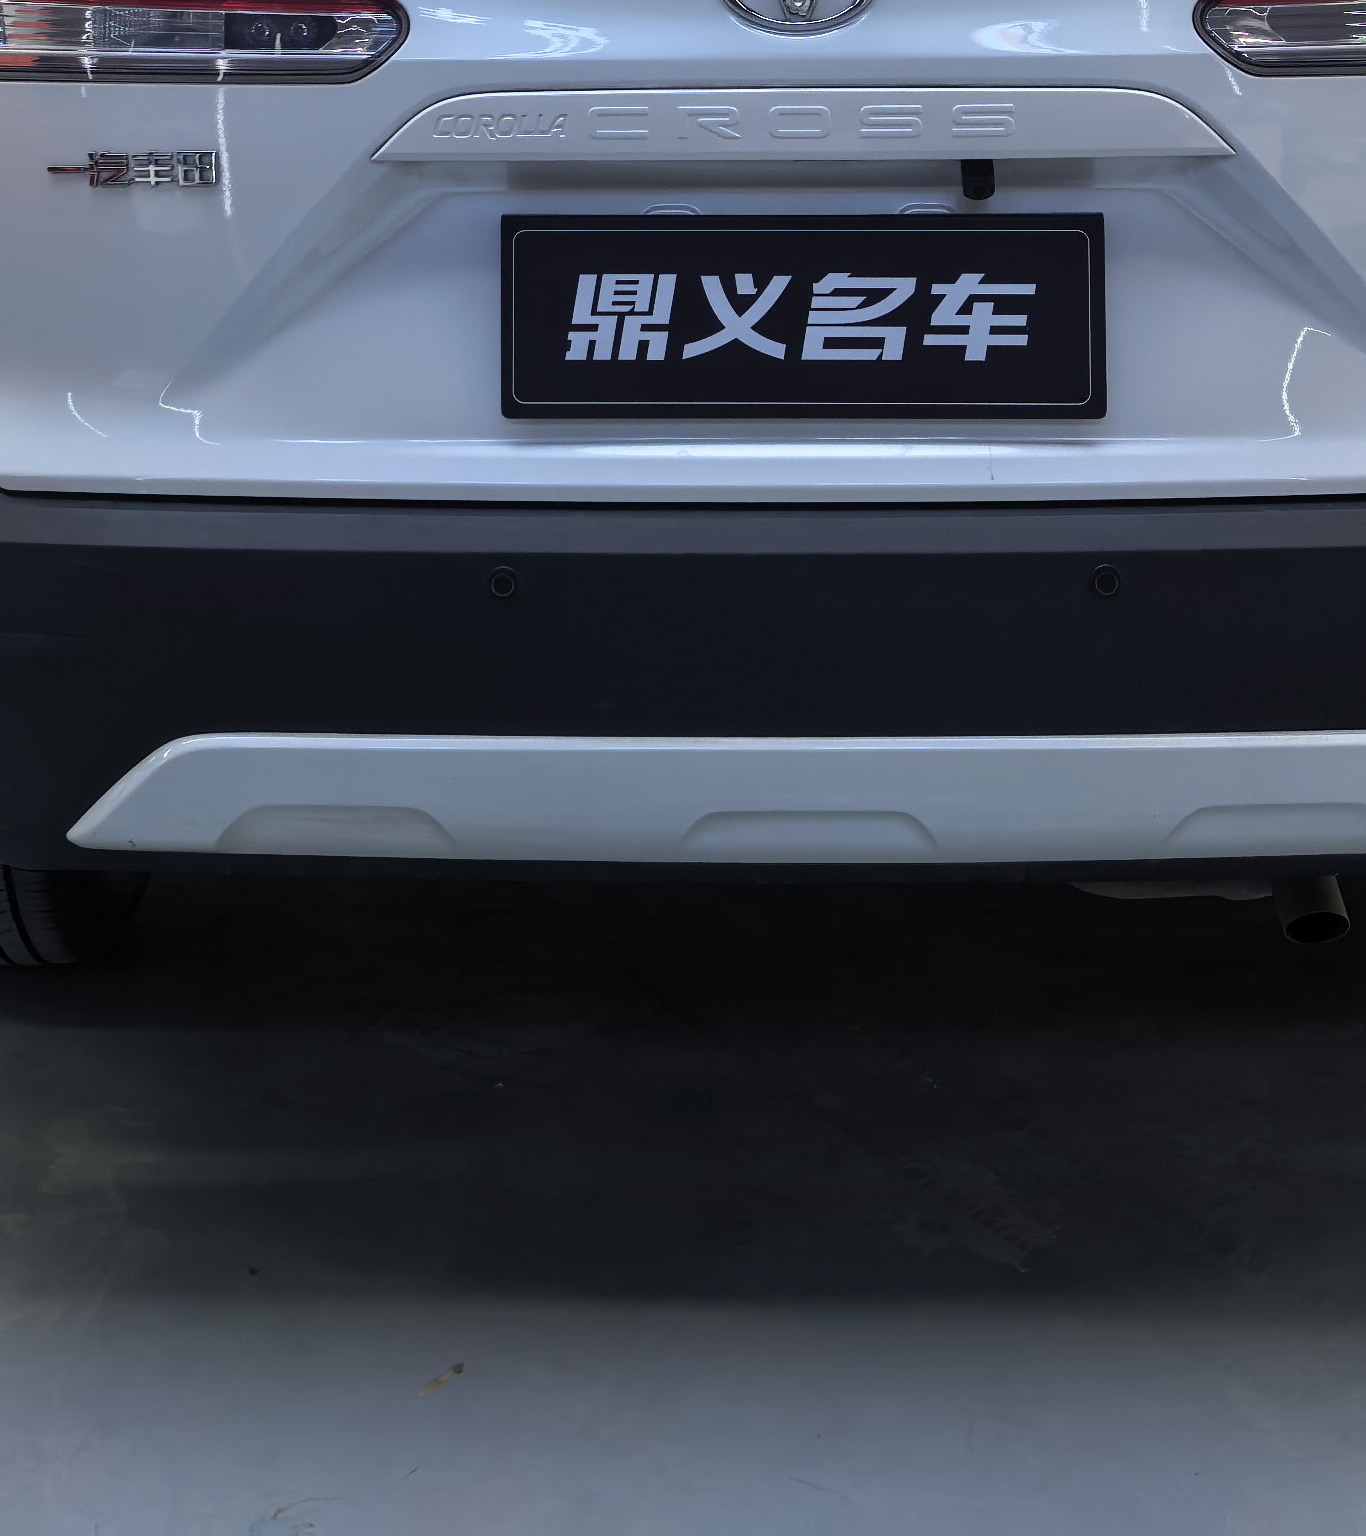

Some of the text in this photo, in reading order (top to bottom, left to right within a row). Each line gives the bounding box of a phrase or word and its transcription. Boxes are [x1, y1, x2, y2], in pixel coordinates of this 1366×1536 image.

[432, 103, 1016, 140] COROLLA CROSS
[565, 273, 1037, 362] 鼎义名车
